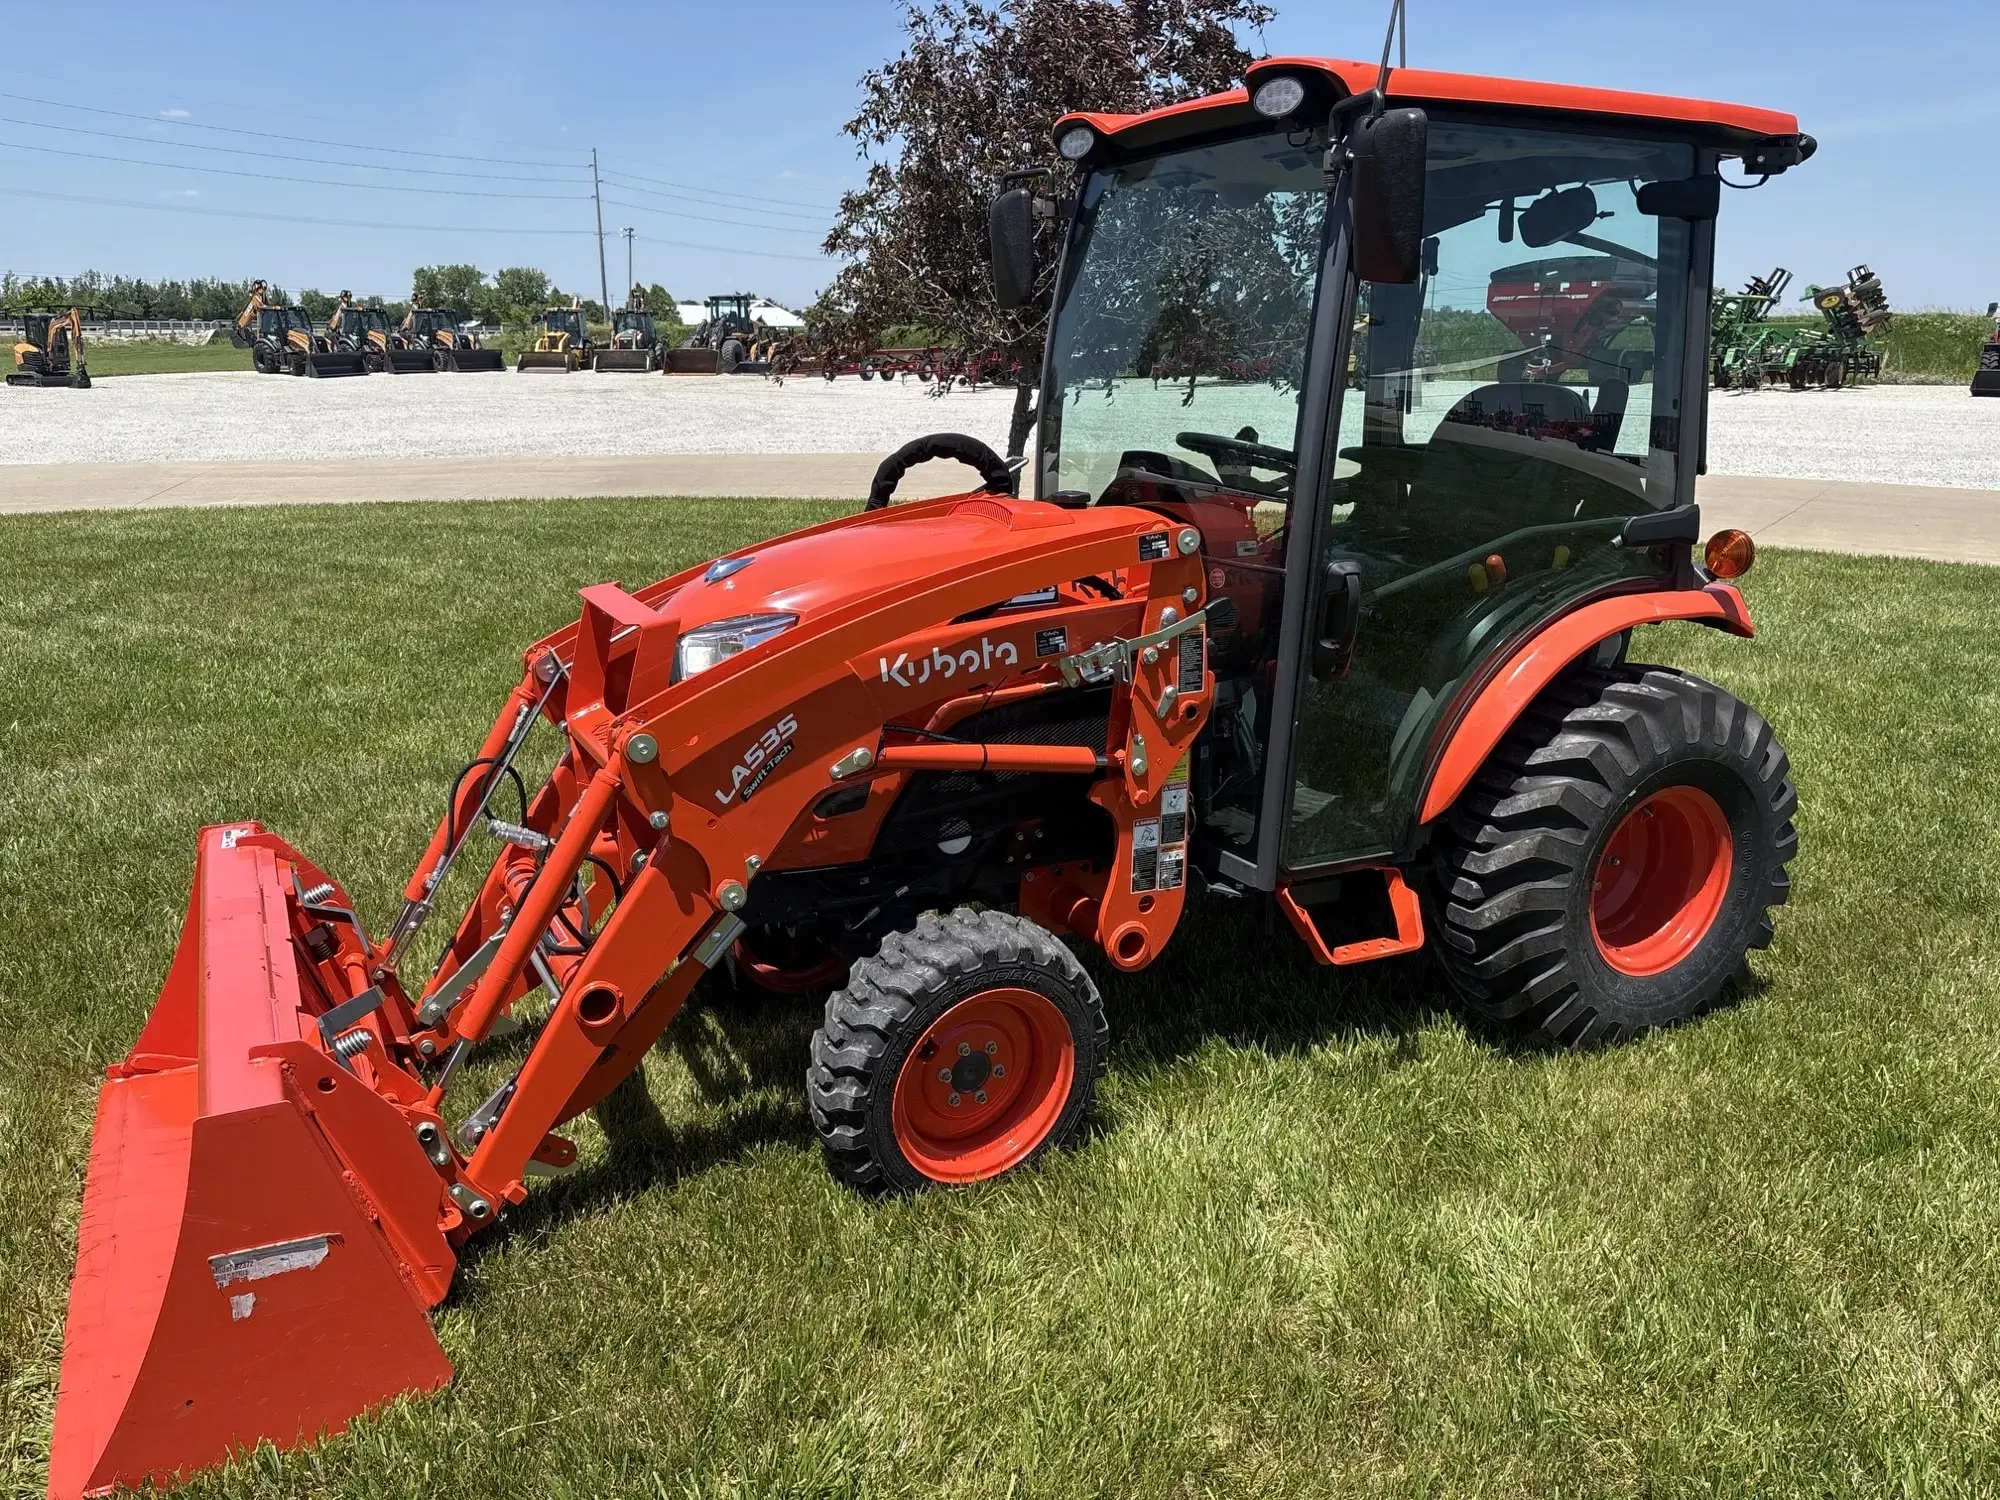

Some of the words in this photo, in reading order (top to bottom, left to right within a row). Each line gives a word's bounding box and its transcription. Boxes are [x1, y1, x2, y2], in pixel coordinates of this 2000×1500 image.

[879, 637, 1018, 688] Kubota
[714, 712, 798, 805] LA535
[743, 743, 792, 799] Swift-Tach
